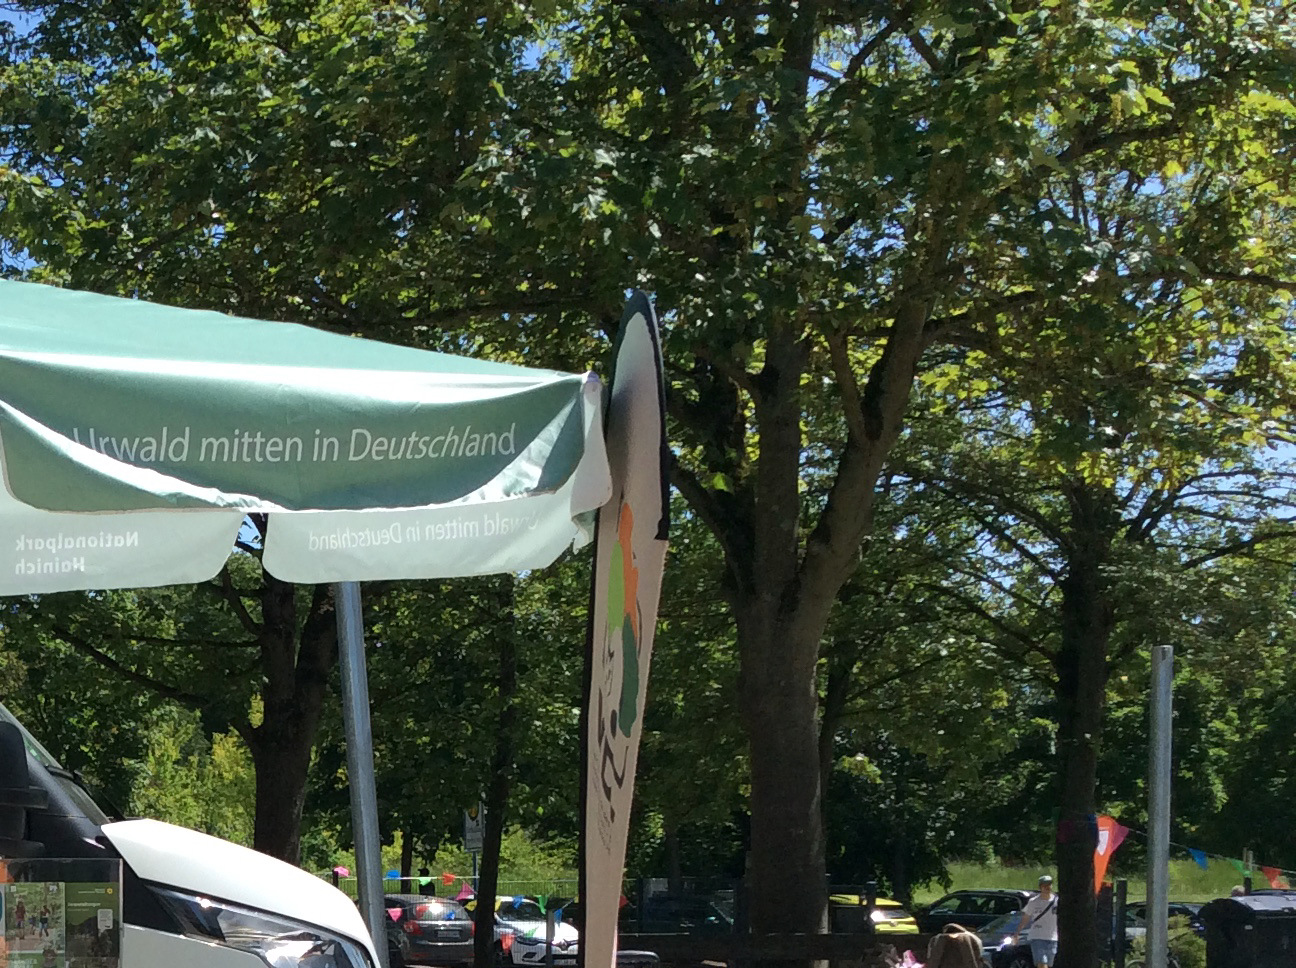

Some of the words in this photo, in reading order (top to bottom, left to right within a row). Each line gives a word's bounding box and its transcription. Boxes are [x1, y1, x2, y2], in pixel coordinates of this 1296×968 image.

[198, 429, 304, 462] mitten
[312, 429, 339, 461] in
[348, 423, 516, 462] Deutschland
